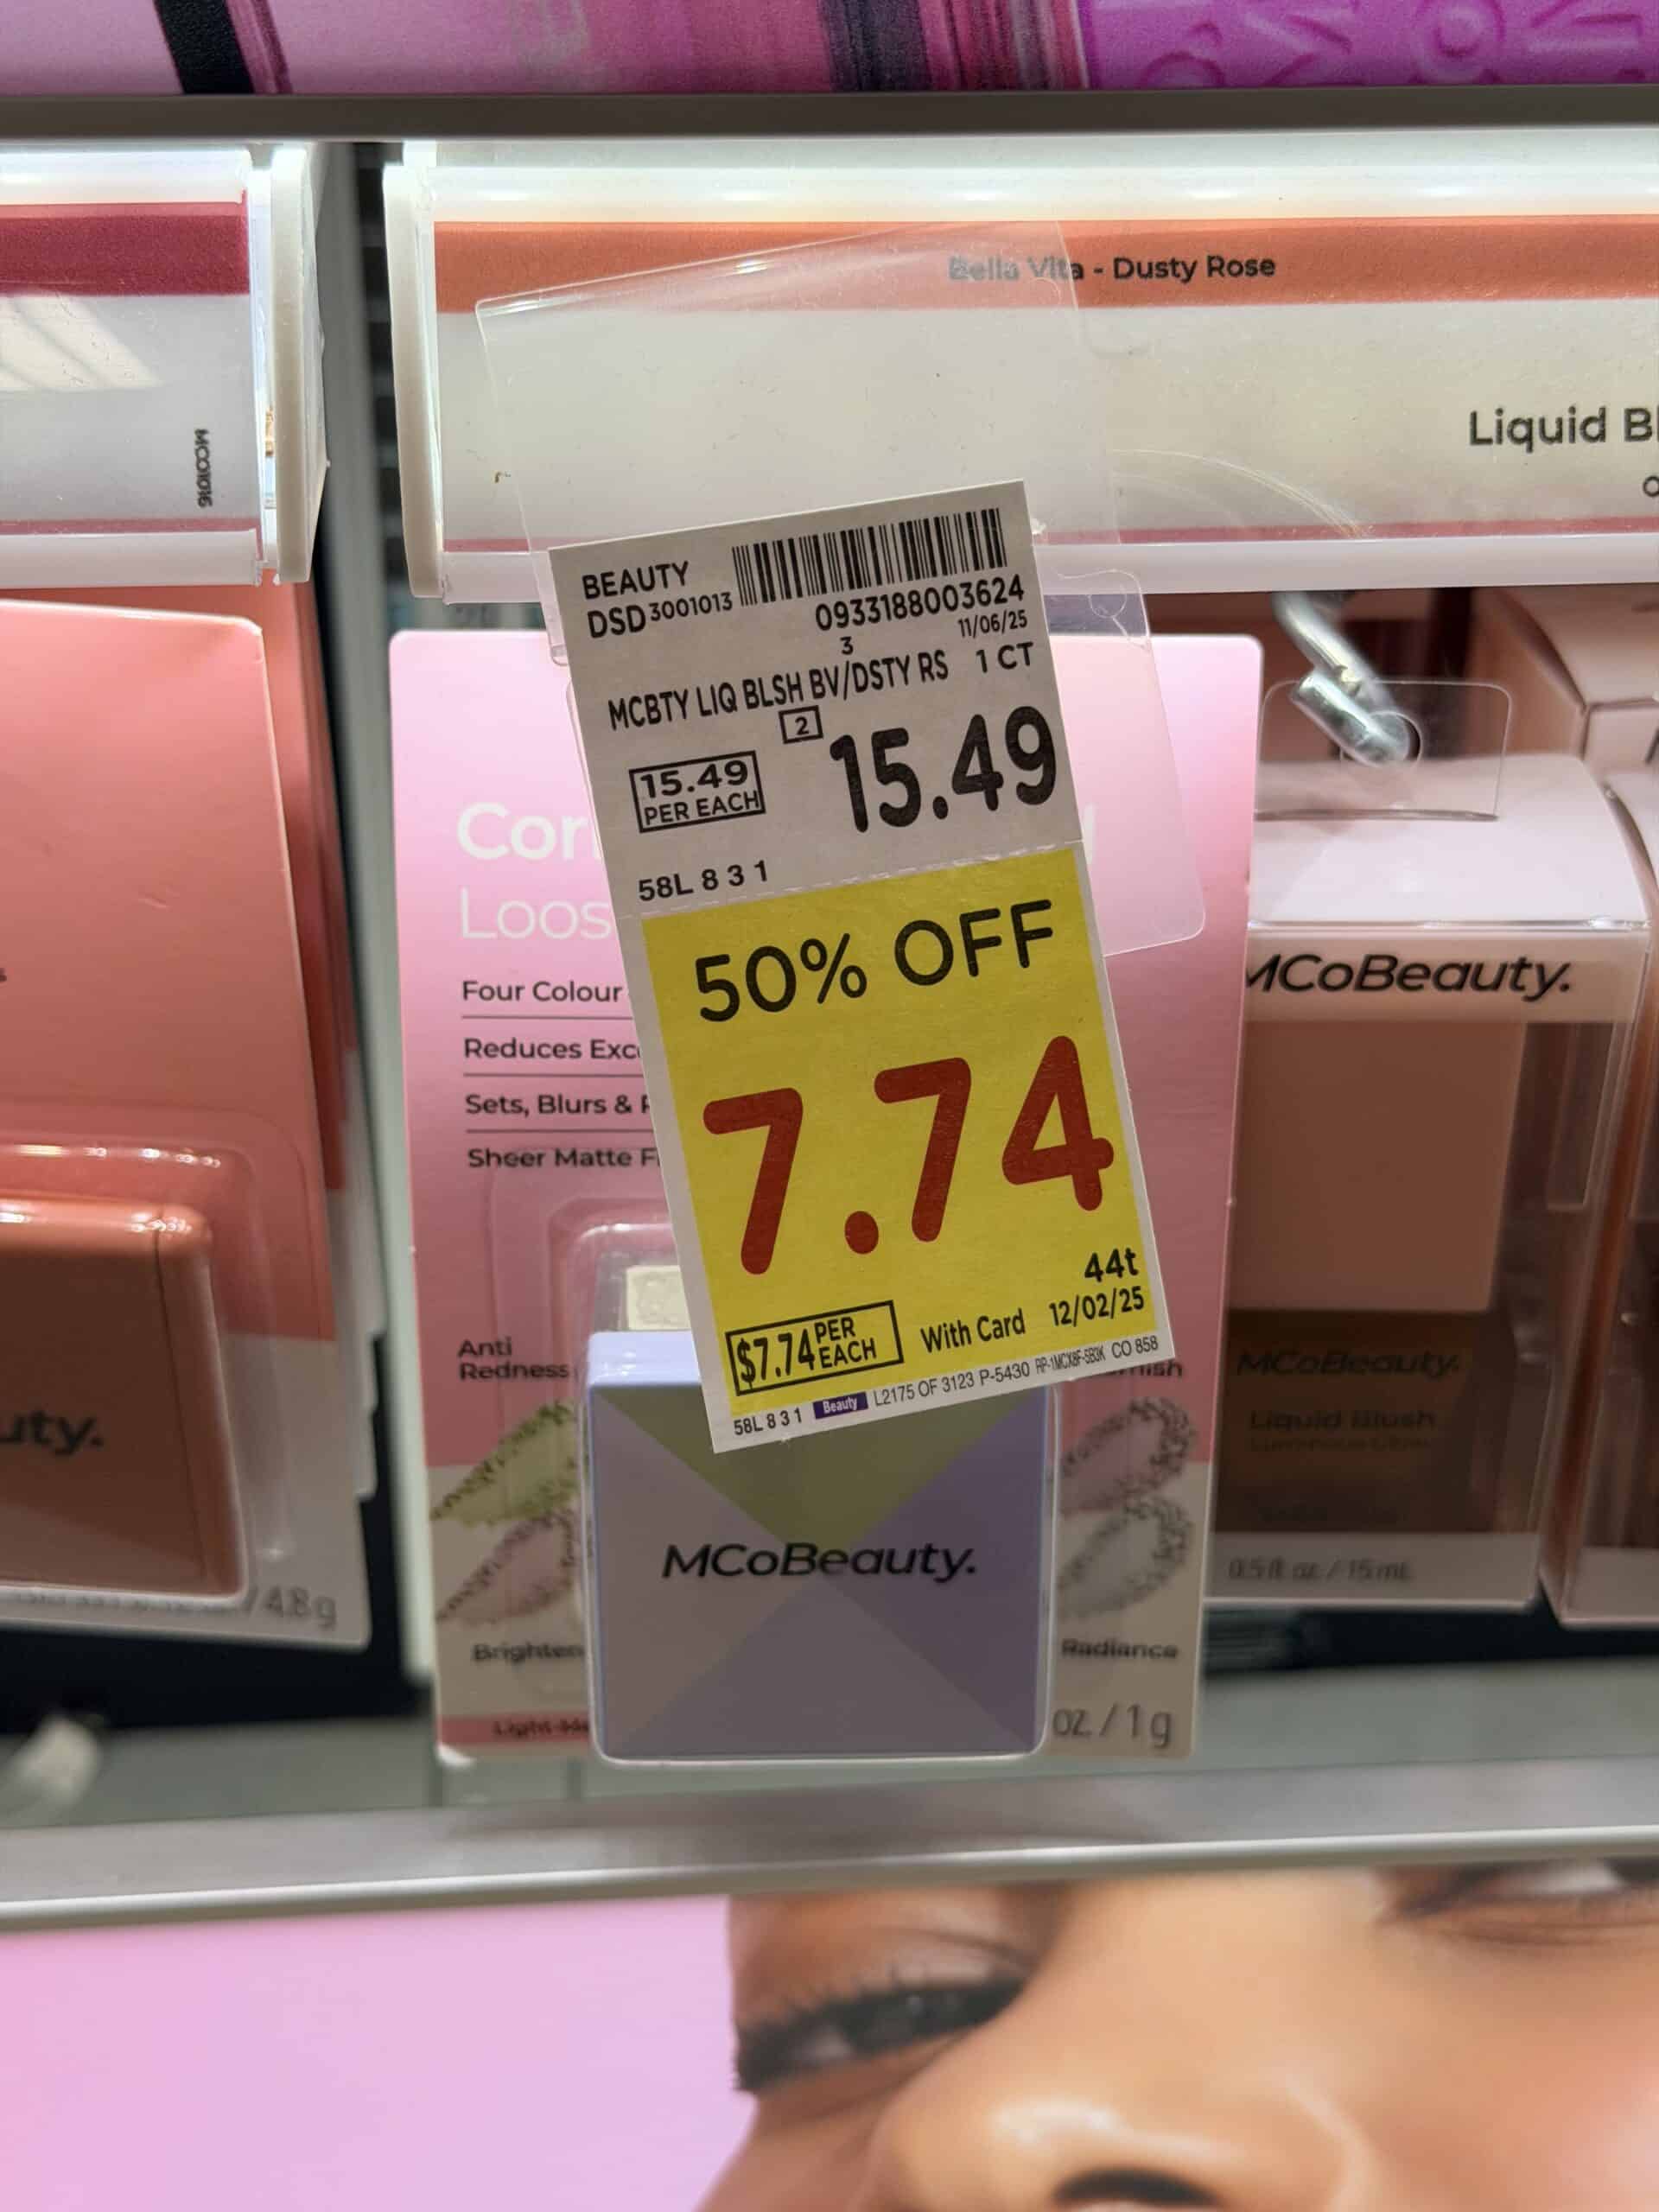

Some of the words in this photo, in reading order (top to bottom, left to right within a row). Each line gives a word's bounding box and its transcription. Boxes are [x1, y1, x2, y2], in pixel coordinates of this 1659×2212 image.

[1114, 257, 1198, 284] Dusty
[1207, 255, 1275, 276] Rose
[1470, 406, 1606, 453] Liquid
[582, 560, 690, 601] BEAUTY
[587, 603, 647, 639] DSD
[649, 592, 733, 622] 3001013
[814, 574, 1025, 632] 0933188003624
[957, 610, 1028, 639] 11/06/25
[840, 637, 854, 655] 3
[607, 690, 690, 731] MCBTY
[696, 683, 738, 719] LIQ
[743, 671, 804, 710] BLSH
[809, 655, 912, 702] BV/DSTY
[918, 649, 949, 682] RS
[976, 649, 987, 673] 1
[996, 641, 1034, 670] CT
[795, 717, 810, 736] 2
[639, 760, 748, 798] 15.49
[829, 705, 1058, 833] 15.49
[643, 801, 690, 826] PER
[696, 792, 759, 819] EACH
[638, 876, 694, 902] 58L
[702, 869, 719, 891] 8
[728, 864, 745, 886] 3
[755, 861, 767, 882] 1
[695, 932, 868, 1022] 50%
[893, 899, 1053, 987] OFF
[462, 980, 524, 1001] Four
[532, 980, 623, 1002] Colour
[464, 1037, 582, 1059] Reduces
[591, 1039, 641, 1060] Exc
[465, 1094, 530, 1118] Sets,
[537, 1094, 607, 1115] Blurs
[614, 1094, 632, 1115] &
[467, 1147, 546, 1168] Sheer
[555, 1147, 632, 1167] Matte
[702, 1035, 1115, 1275] 7.74
[1084, 1248, 1139, 1284] 44t
[1049, 1286, 1145, 1328] 12/02/25
[814, 1316, 855, 1341] PER
[920, 1319, 970, 1354] With
[976, 1308, 1025, 1345] Card
[458, 1337, 512, 1357] Anti
[737, 1326, 816, 1389] $7.74
[818, 1339, 876, 1368] EACH
[460, 1363, 569, 1380] Redness
[874, 1381, 915, 1408] L2175
[918, 1379, 938, 1398] OF
[942, 1371, 975, 1395] 3123
[978, 1361, 1030, 1387] P-5430
[1111, 1340, 1132, 1359] CO
[1135, 1335, 1159, 1354] 858
[734, 1415, 764, 1436] 58L
[766, 1412, 777, 1430] 8
[780, 1408, 791, 1427] 3
[794, 1408, 802, 1424] 1
[822, 1395, 858, 1416] Beauty
[662, 1542, 977, 1583] MCoBeauty.
[1062, 1638, 1178, 1659] Radiance
